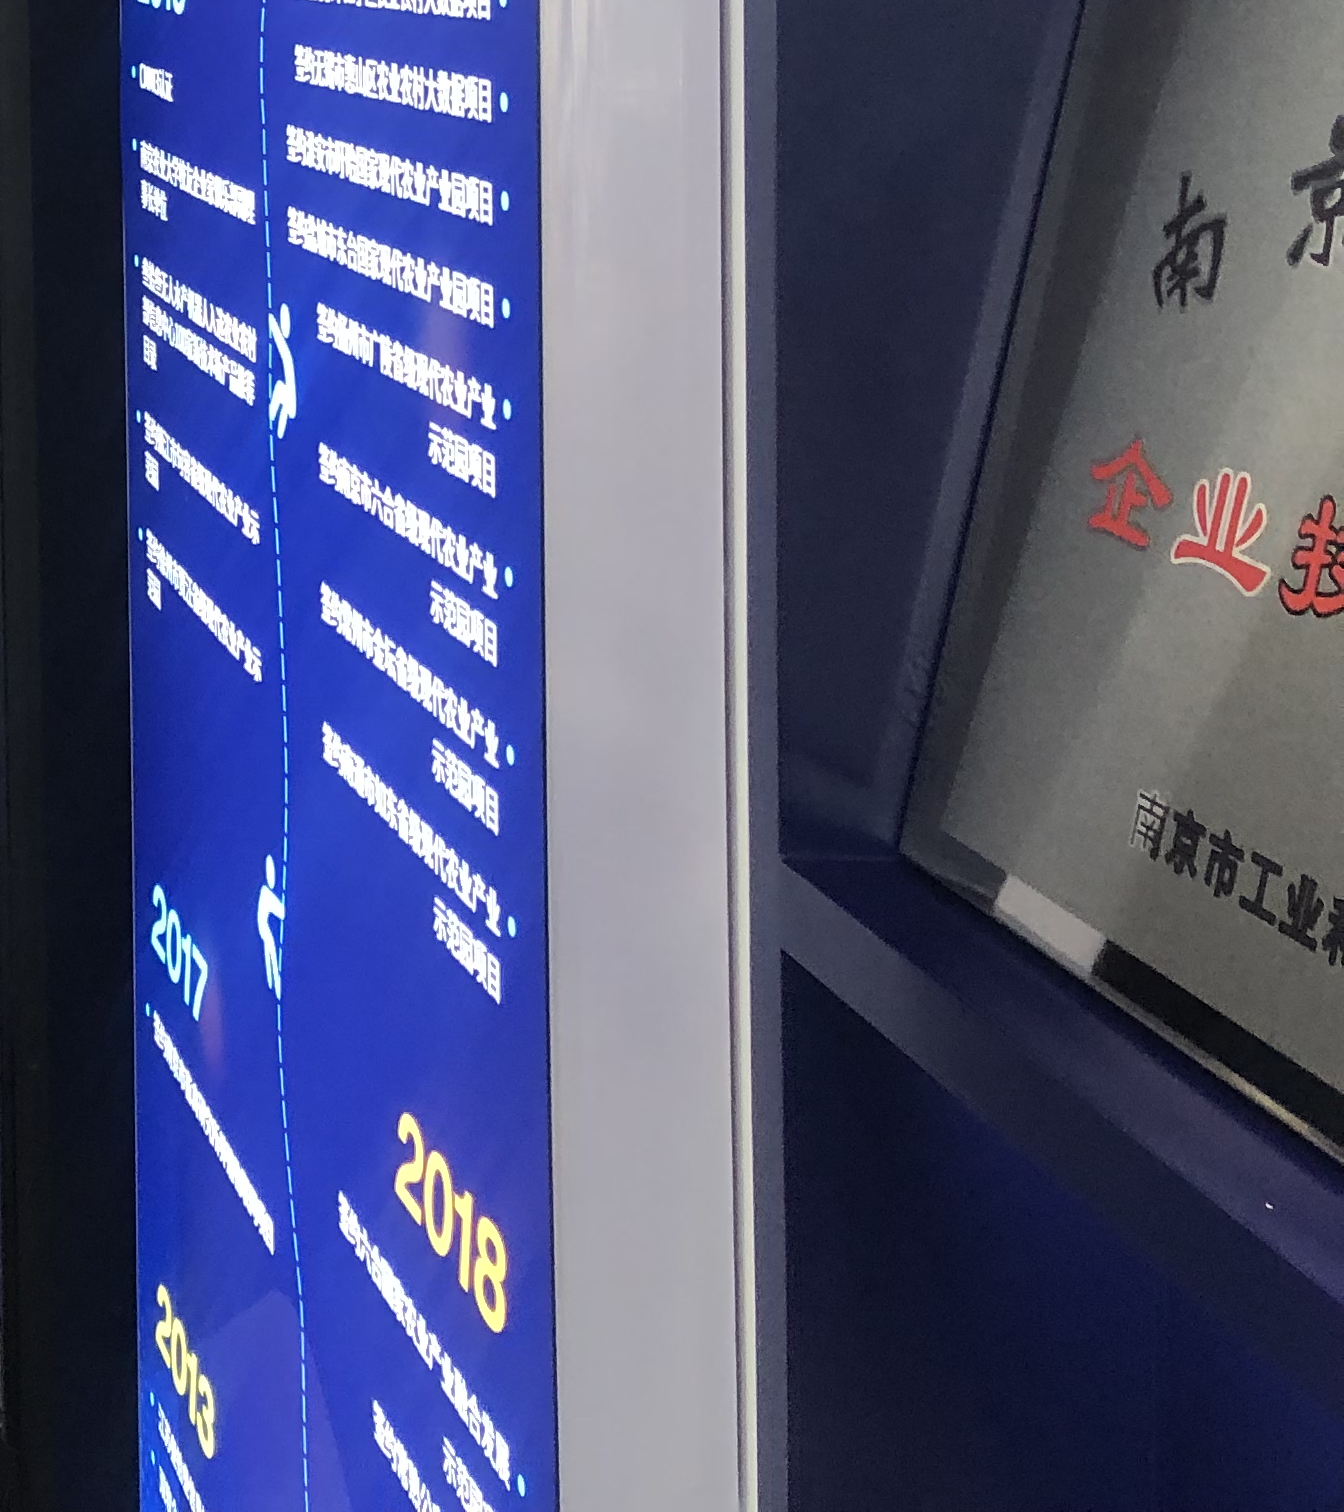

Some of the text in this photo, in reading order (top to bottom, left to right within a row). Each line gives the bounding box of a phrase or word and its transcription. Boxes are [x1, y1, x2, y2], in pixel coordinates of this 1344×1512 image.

[429, 422, 495, 498] 示范园项目
[430, 581, 497, 667] 示范园项目
[432, 739, 498, 835] 示范园项目
[152, 885, 208, 1021] 2017
[434, 897, 500, 1004] 示范园项目
[395, 1112, 507, 1333] 2018
[156, 1285, 214, 1458] 2013
